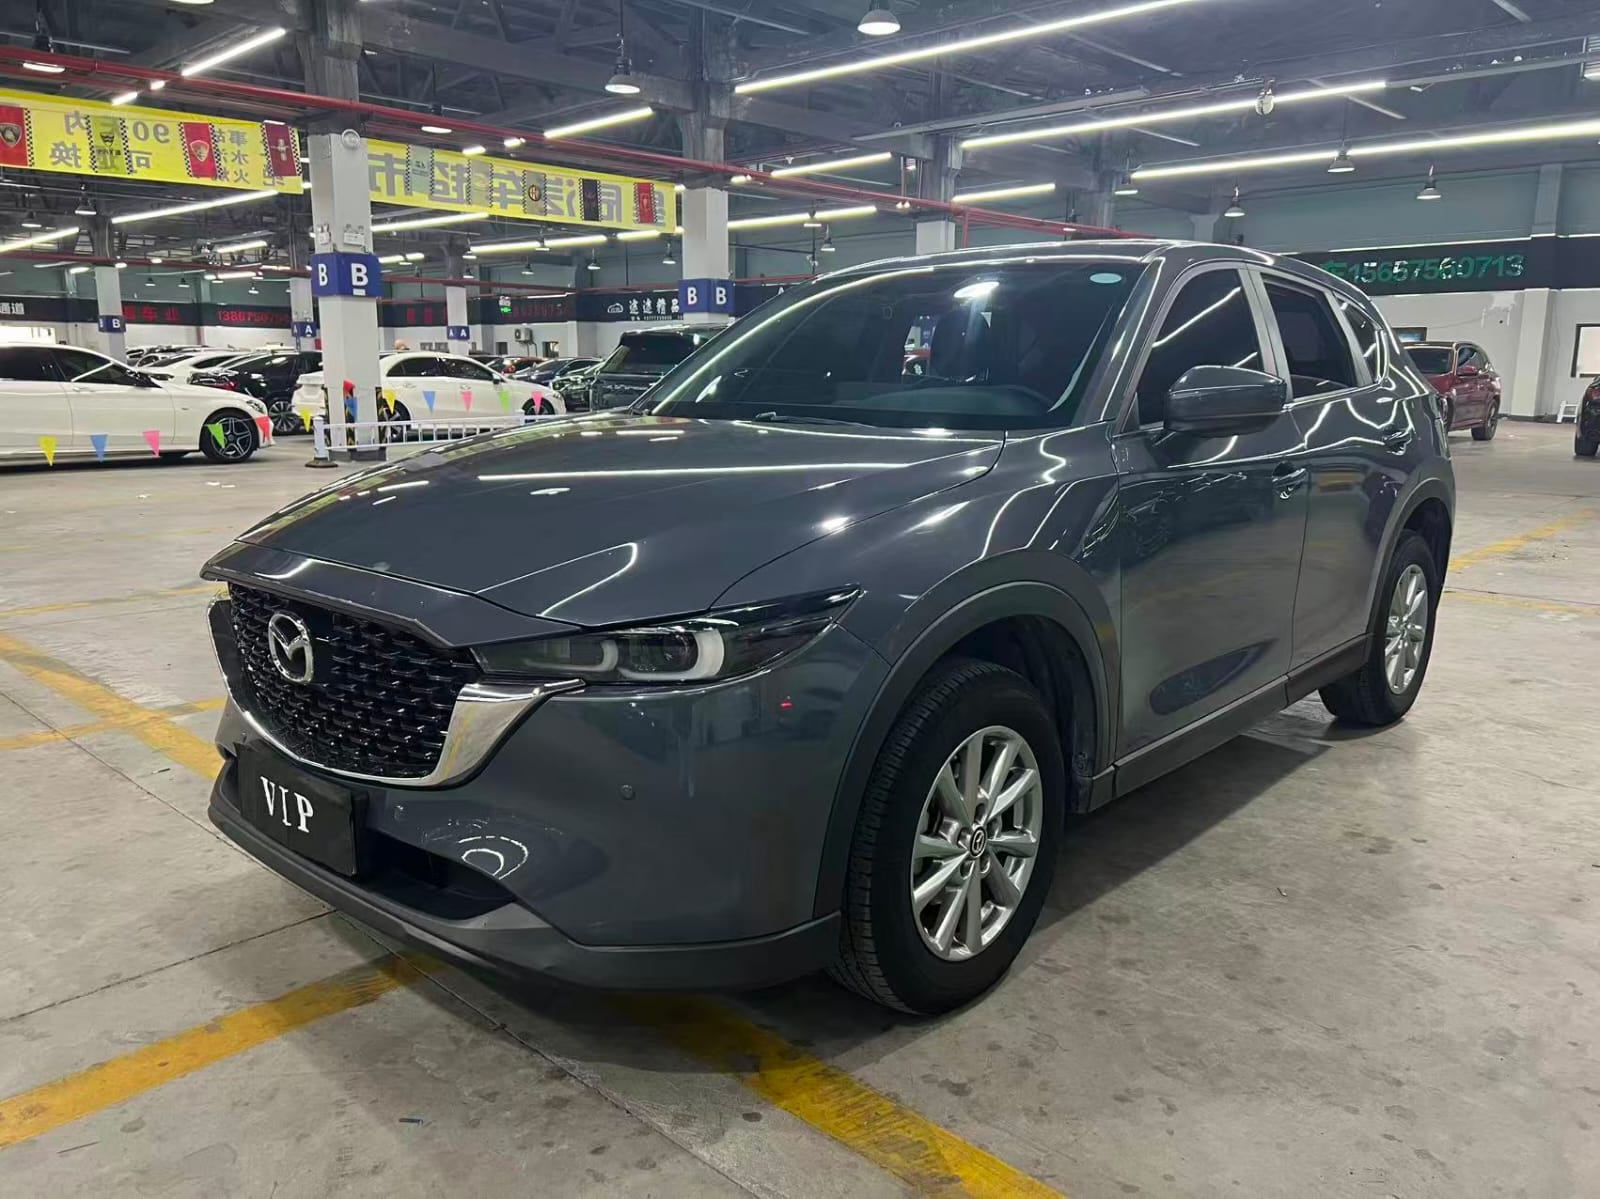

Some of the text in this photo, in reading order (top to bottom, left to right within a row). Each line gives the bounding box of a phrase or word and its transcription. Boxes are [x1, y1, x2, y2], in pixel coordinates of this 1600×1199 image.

[318, 263, 328, 286] B
[351, 263, 368, 286] B
[687, 287, 698, 305] B
[716, 287, 727, 305] B
[112, 318, 120, 328] B
[304, 325, 313, 335] A
[460, 329, 467, 337] A
[259, 776, 314, 833] VIP
